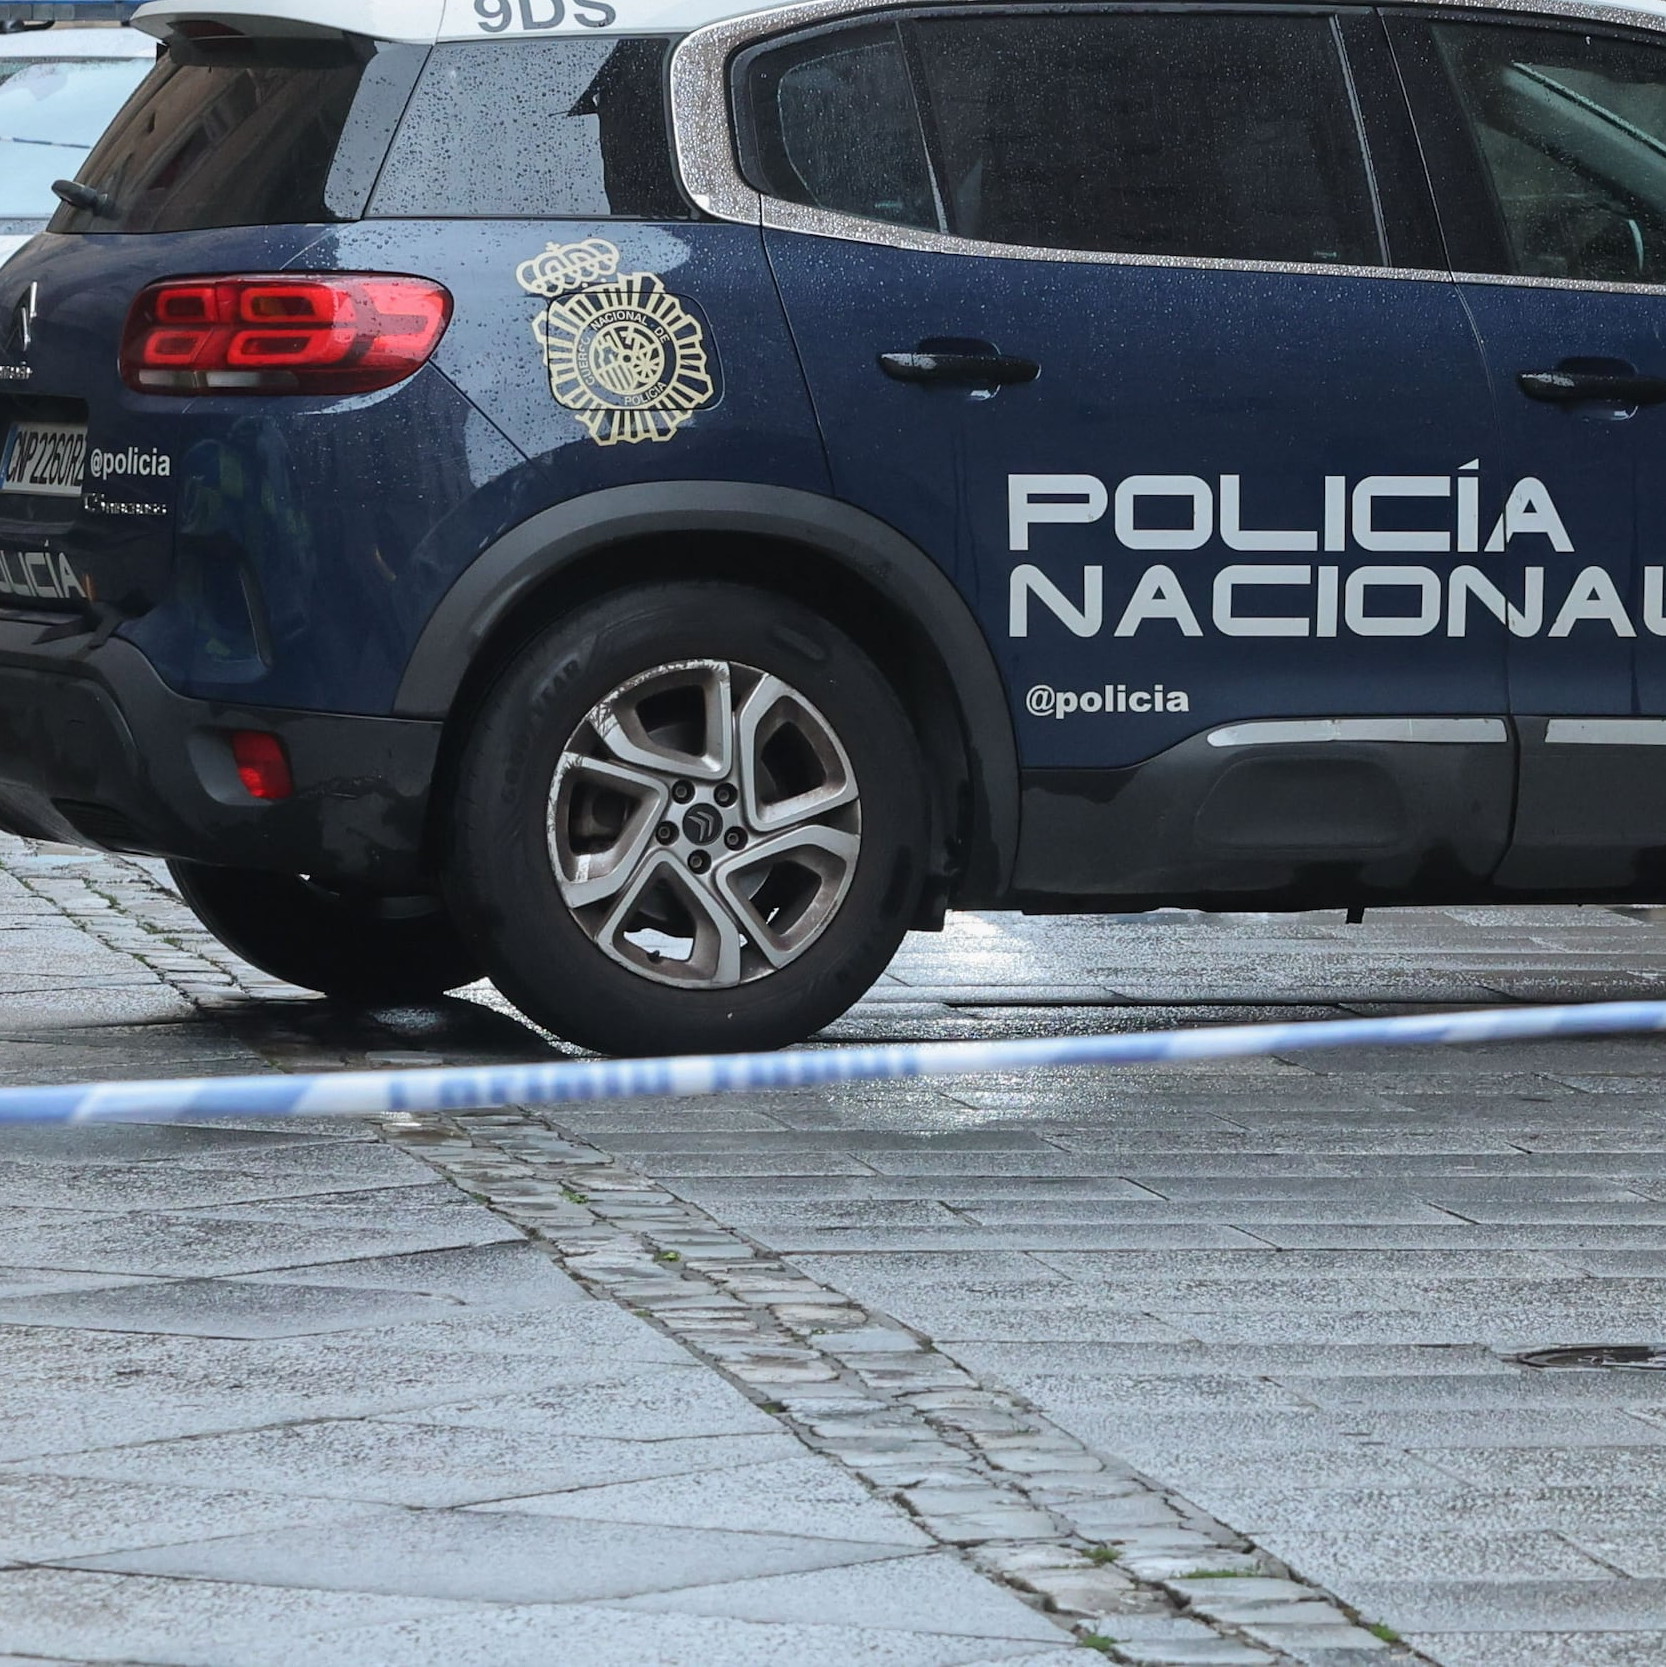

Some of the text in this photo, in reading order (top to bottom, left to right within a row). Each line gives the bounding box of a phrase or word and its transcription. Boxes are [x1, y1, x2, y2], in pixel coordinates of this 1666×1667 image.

[591, 311, 648, 331] NACIONAL
[654, 327, 670, 344] DE
[90, 446, 172, 481] @policia
[1008, 458, 1574, 553] POLICÍA
[1025, 684, 1190, 720] @policia
